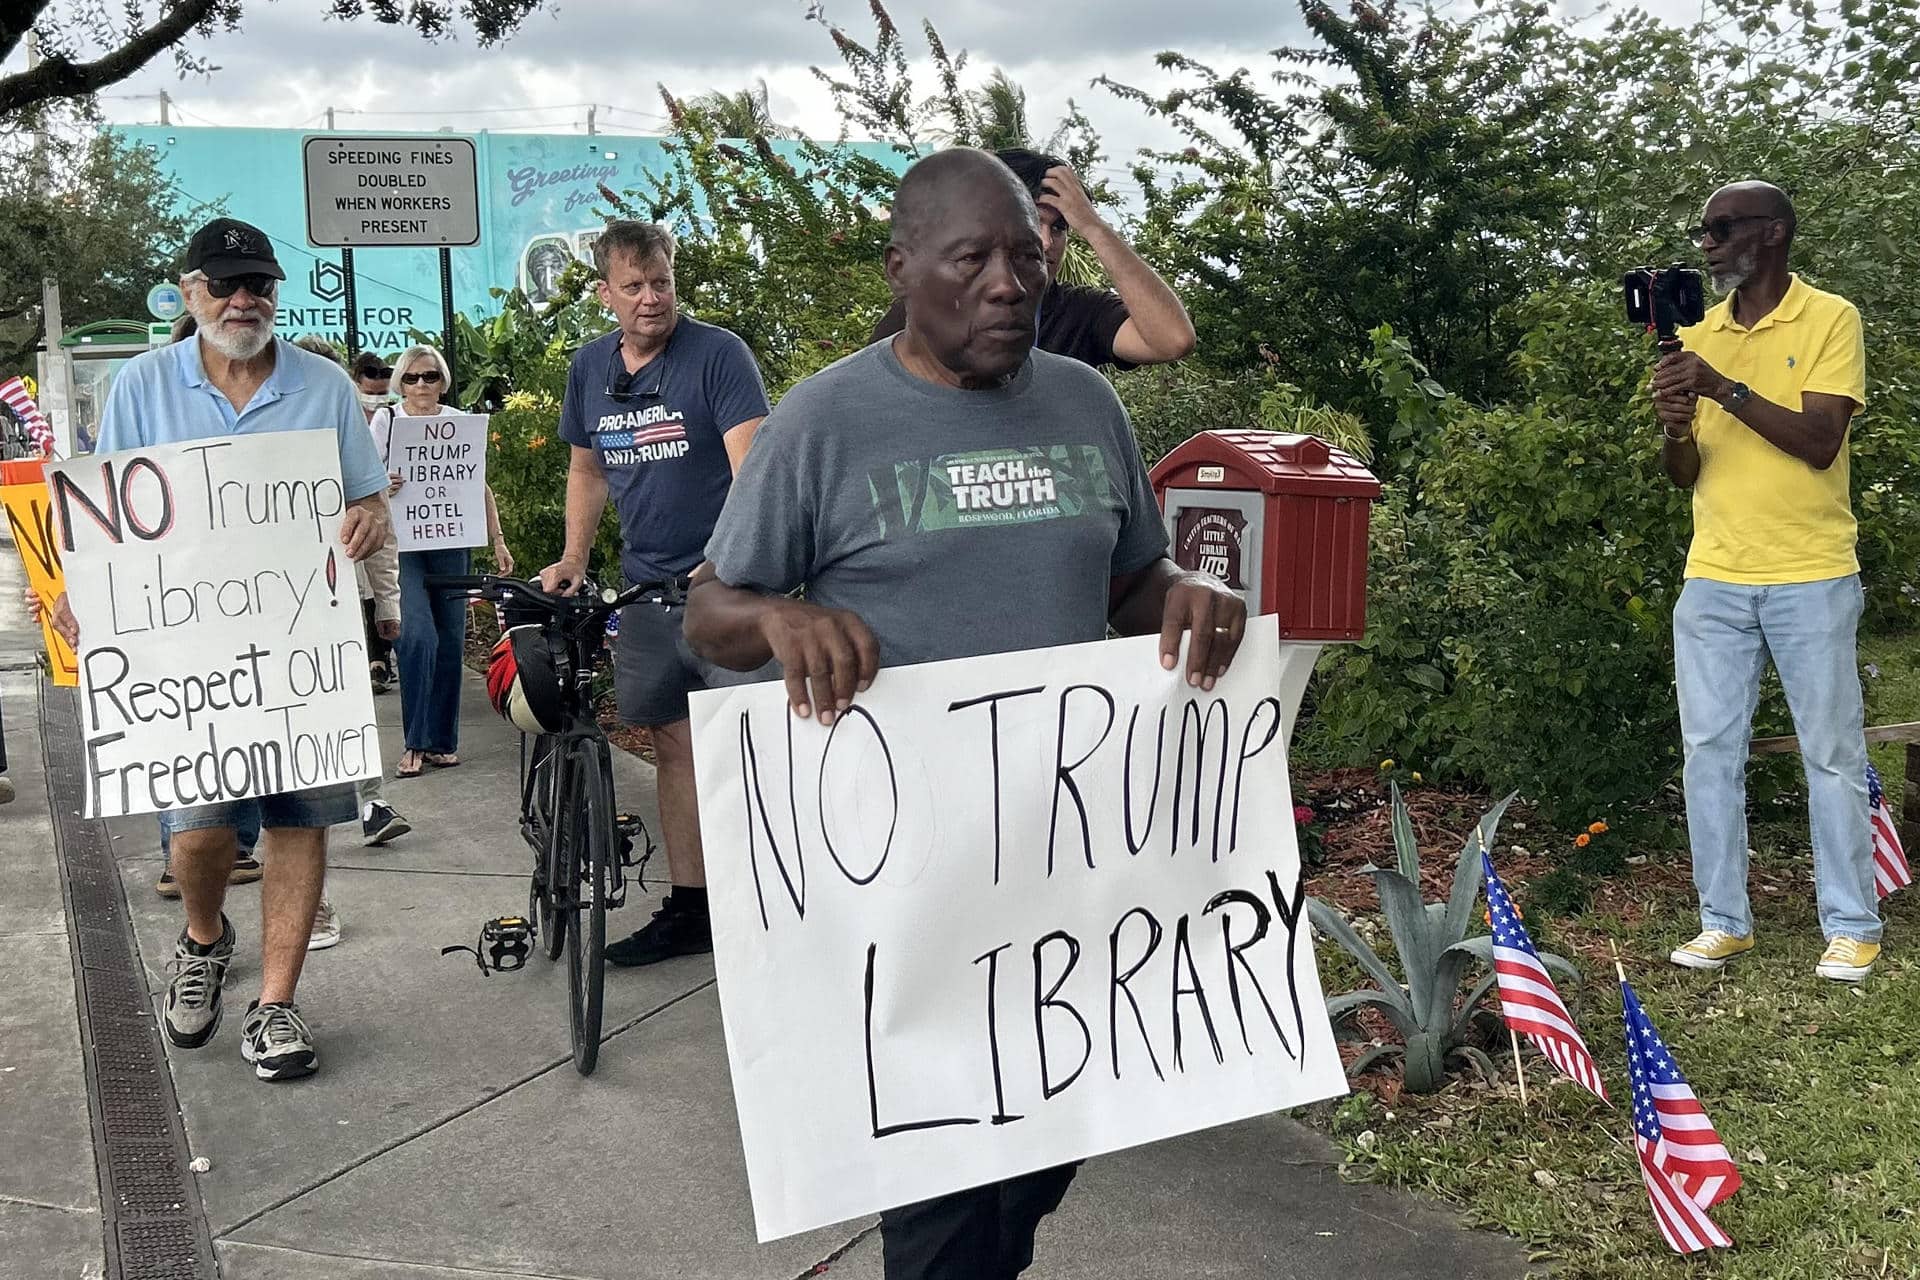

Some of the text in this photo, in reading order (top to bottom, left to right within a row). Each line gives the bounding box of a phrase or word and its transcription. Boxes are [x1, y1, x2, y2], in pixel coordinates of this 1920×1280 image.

[328, 151, 453, 165] SPEEDING FINES
[358, 174, 426, 188] DOUBLED
[507, 163, 619, 207] Greetings
[335, 197, 451, 211] WHEN WORKERS
[361, 220, 428, 234] PRESENT
[363, 308, 413, 326] FOR
[425, 421, 456, 440] NO
[405, 443, 471, 461] TRUMP
[947, 460, 1052, 485] TEACH the
[50, 442, 343, 552] NO Trump
[425, 486, 446, 499] OR
[952, 477, 1056, 510] TRUTH
[406, 503, 463, 520] HOTEL
[1017, 505, 1060, 520] FLORIDA
[413, 522, 464, 540] HERE!
[1203, 529, 1226, 542] LITTLE
[1199, 543, 1229, 556] LIBRARY
[108, 546, 339, 635] Library!
[84, 640, 362, 731] Respect our
[87, 703, 378, 818] Freedom Tower
[740, 685, 1281, 931] NO TRUMP
[865, 869, 1304, 1138] LIBRARY
